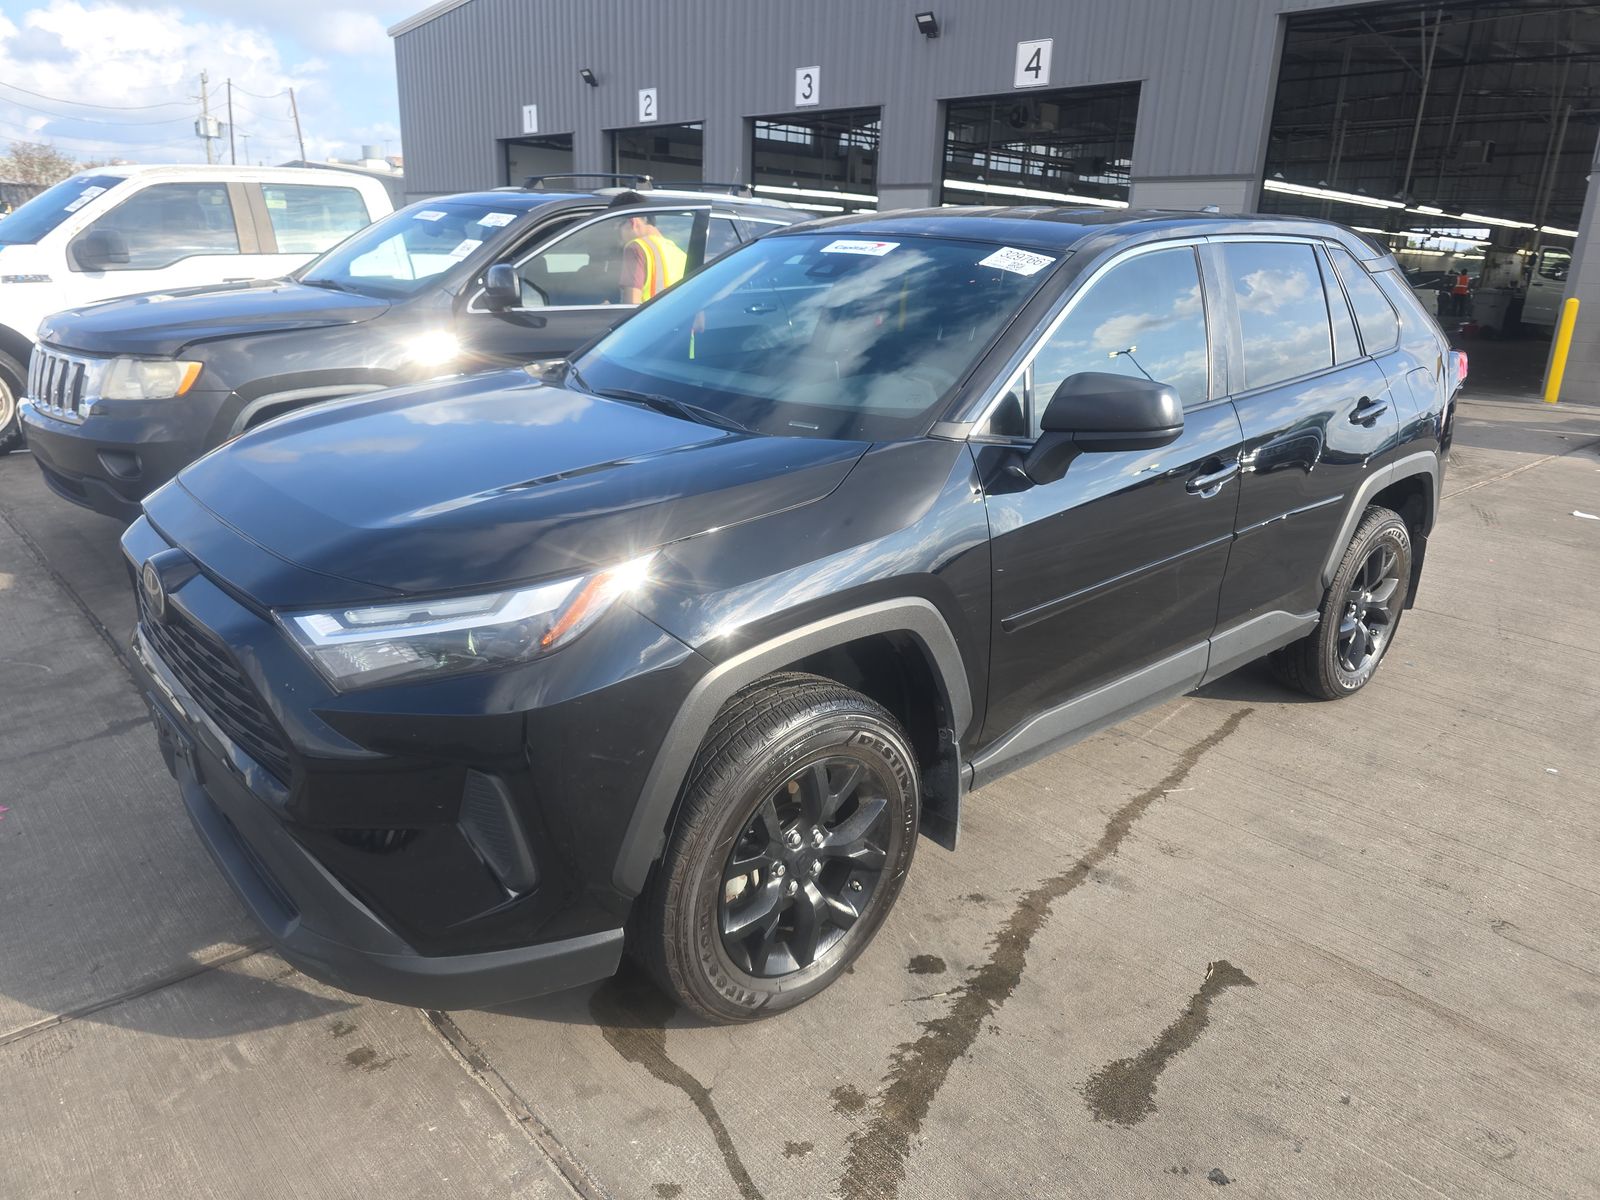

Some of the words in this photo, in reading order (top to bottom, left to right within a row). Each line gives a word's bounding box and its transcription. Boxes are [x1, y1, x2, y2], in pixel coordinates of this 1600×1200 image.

[1024, 47, 1042, 79] 4
[801, 73, 813, 100] 3
[644, 94, 653, 117] 2
